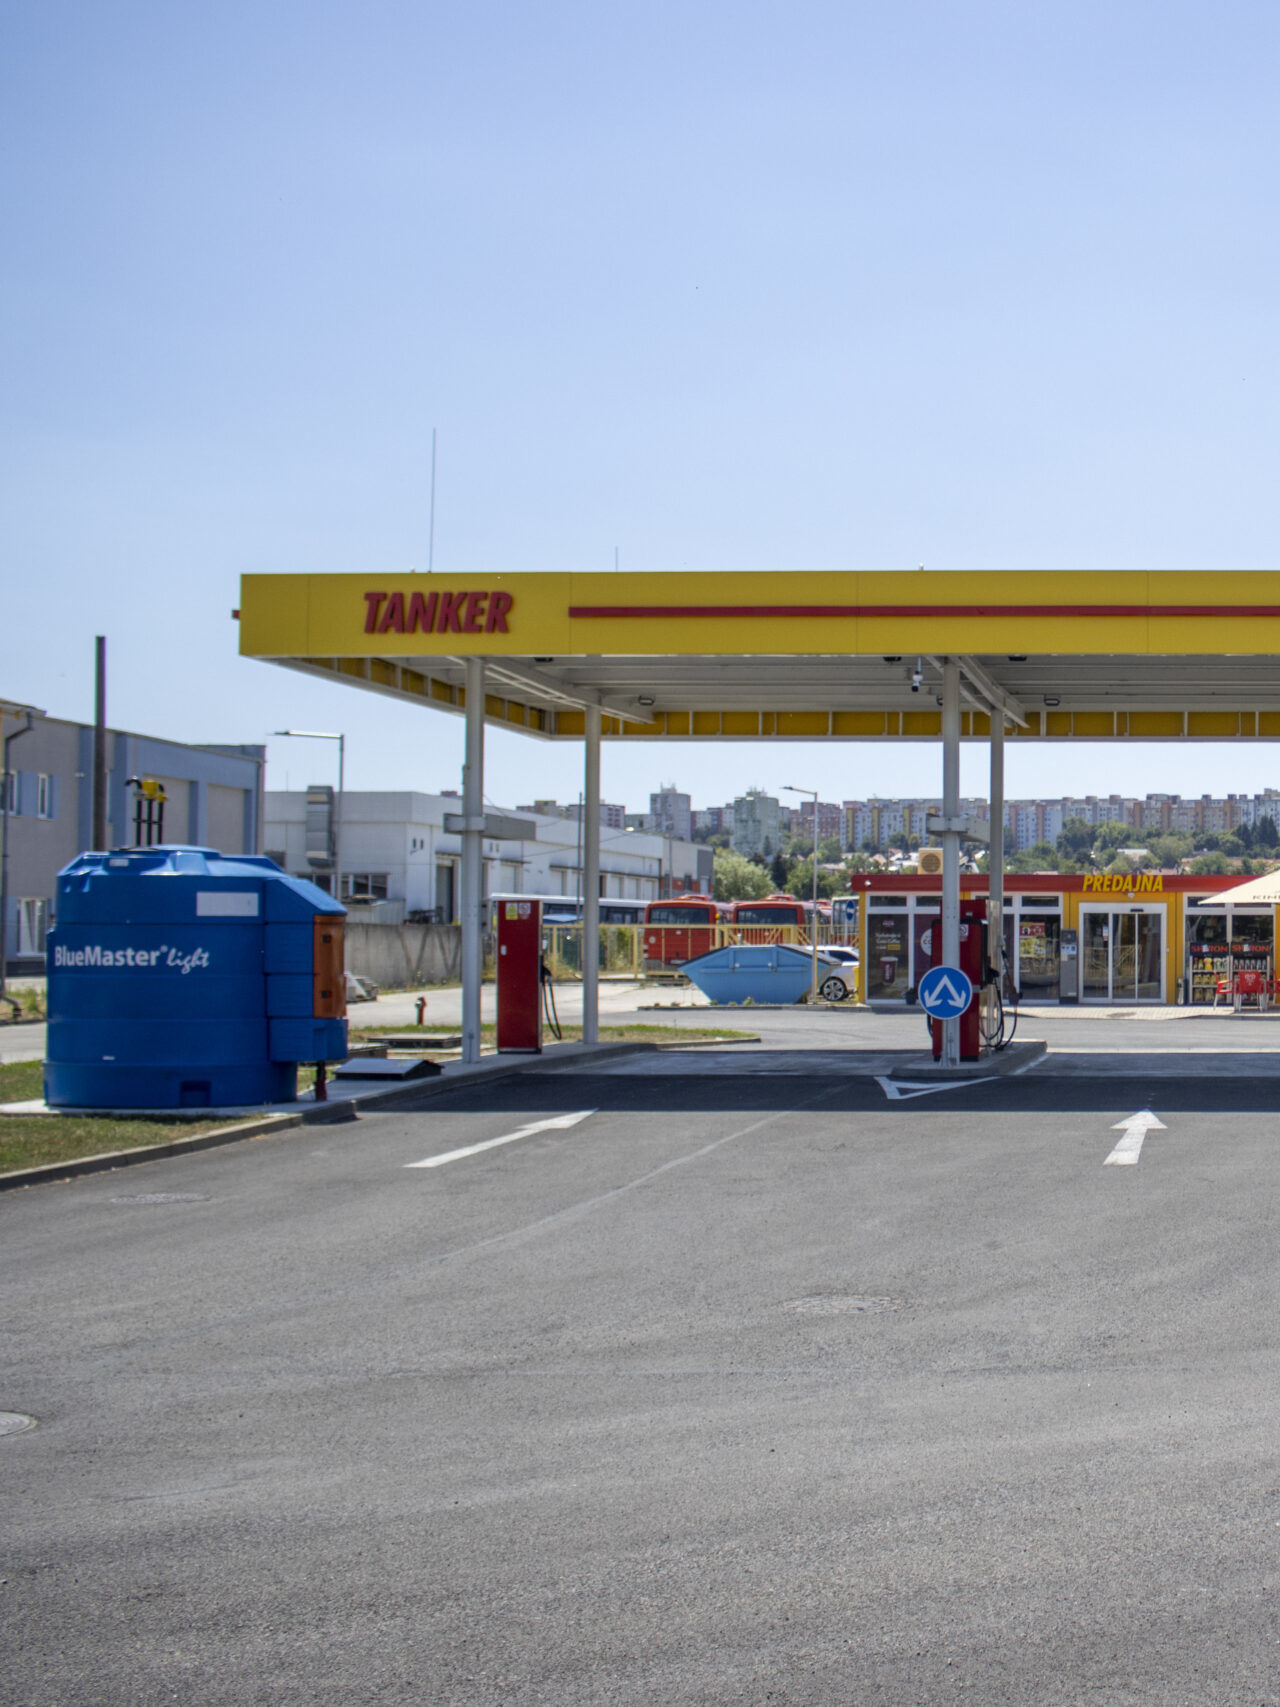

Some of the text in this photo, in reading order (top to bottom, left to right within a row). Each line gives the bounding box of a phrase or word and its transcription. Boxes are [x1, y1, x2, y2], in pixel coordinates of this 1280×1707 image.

[363, 591, 513, 634] TANKER
[1082, 874, 1164, 892] PREDAJNA
[54, 945, 210, 975] BlueMaster light
